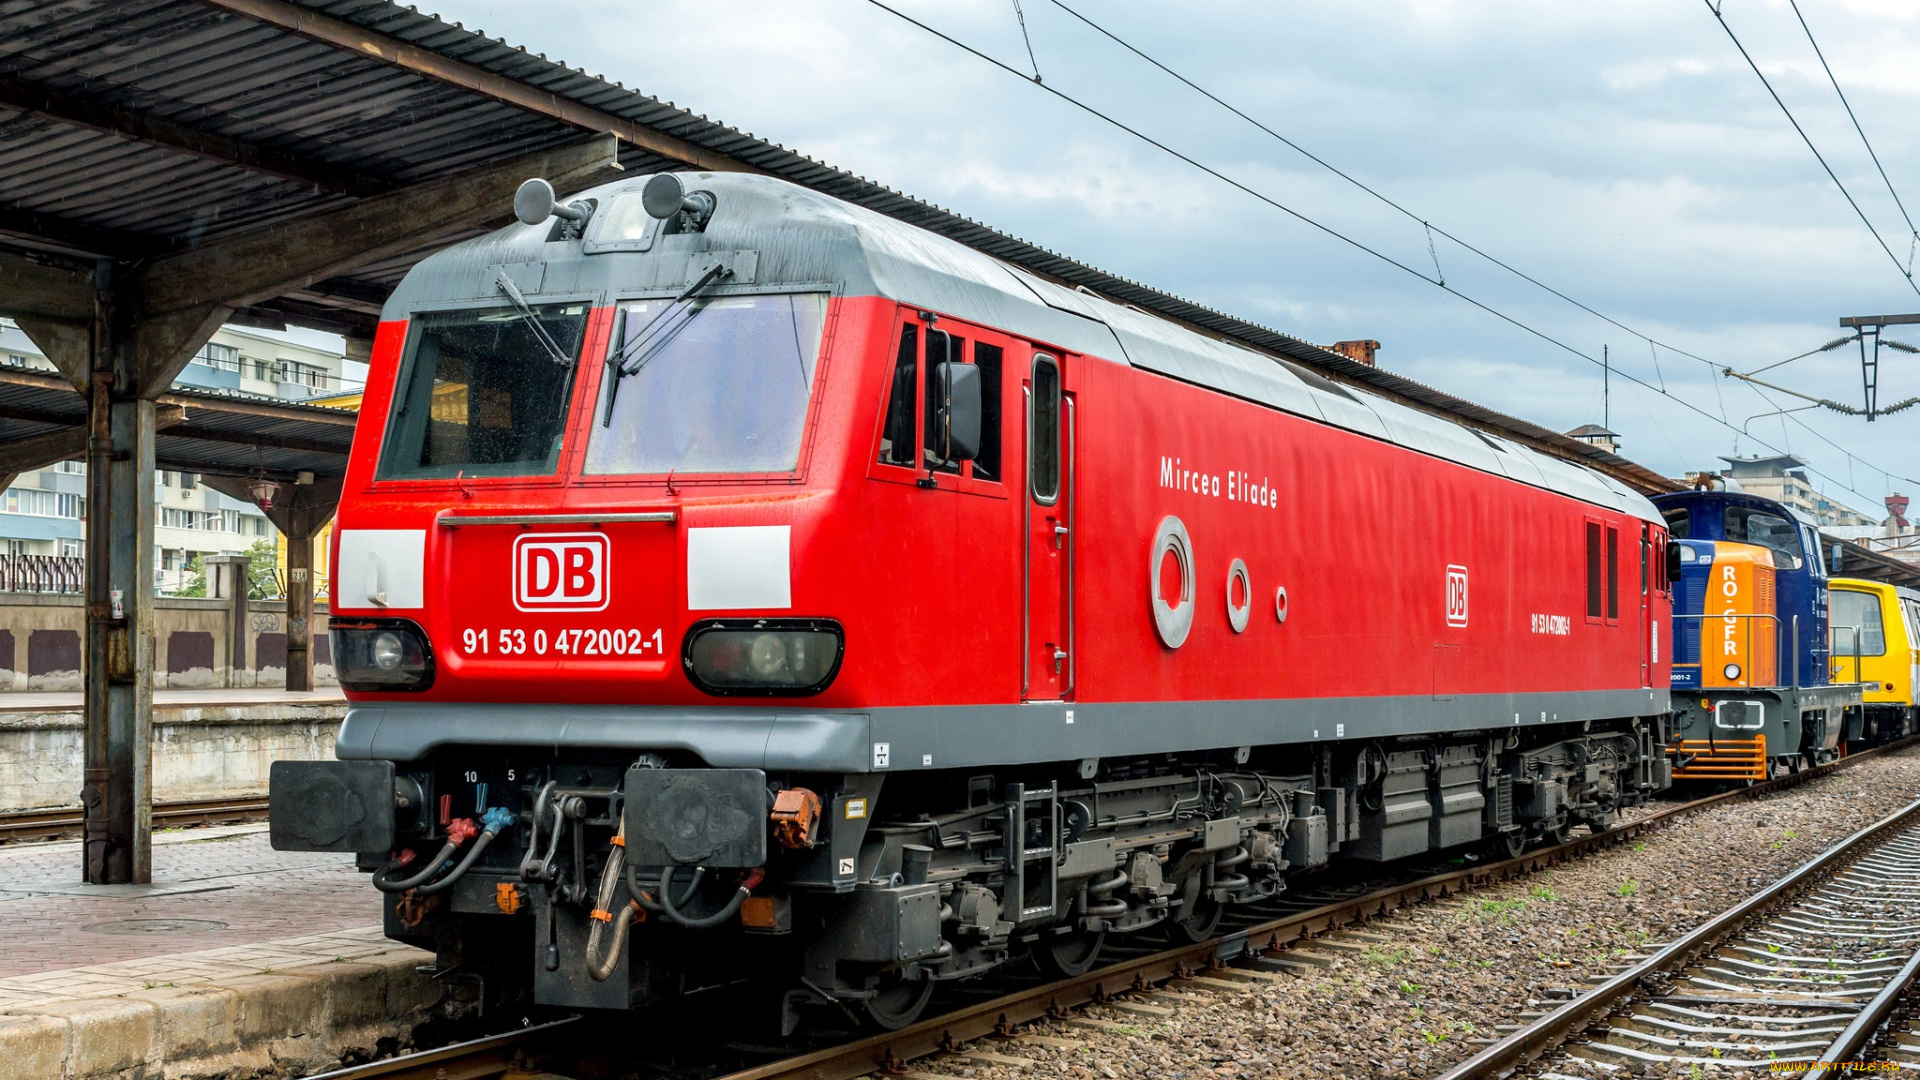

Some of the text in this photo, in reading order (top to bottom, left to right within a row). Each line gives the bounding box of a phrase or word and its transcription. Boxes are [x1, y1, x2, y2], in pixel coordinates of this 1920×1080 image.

[1160, 455, 1278, 509] Mircea Eliade
[527, 546, 596, 598] DB
[1449, 576, 1465, 616] DB
[1722, 565, 1738, 656] RO-GFR
[1531, 613, 1538, 634] 91
[1538, 613, 1546, 635] 53
[1546, 614, 1550, 635] 0
[463, 628, 663, 655] 91 53 0 472002-1
[464, 770, 477, 782] 10
[508, 769, 515, 781] 5
